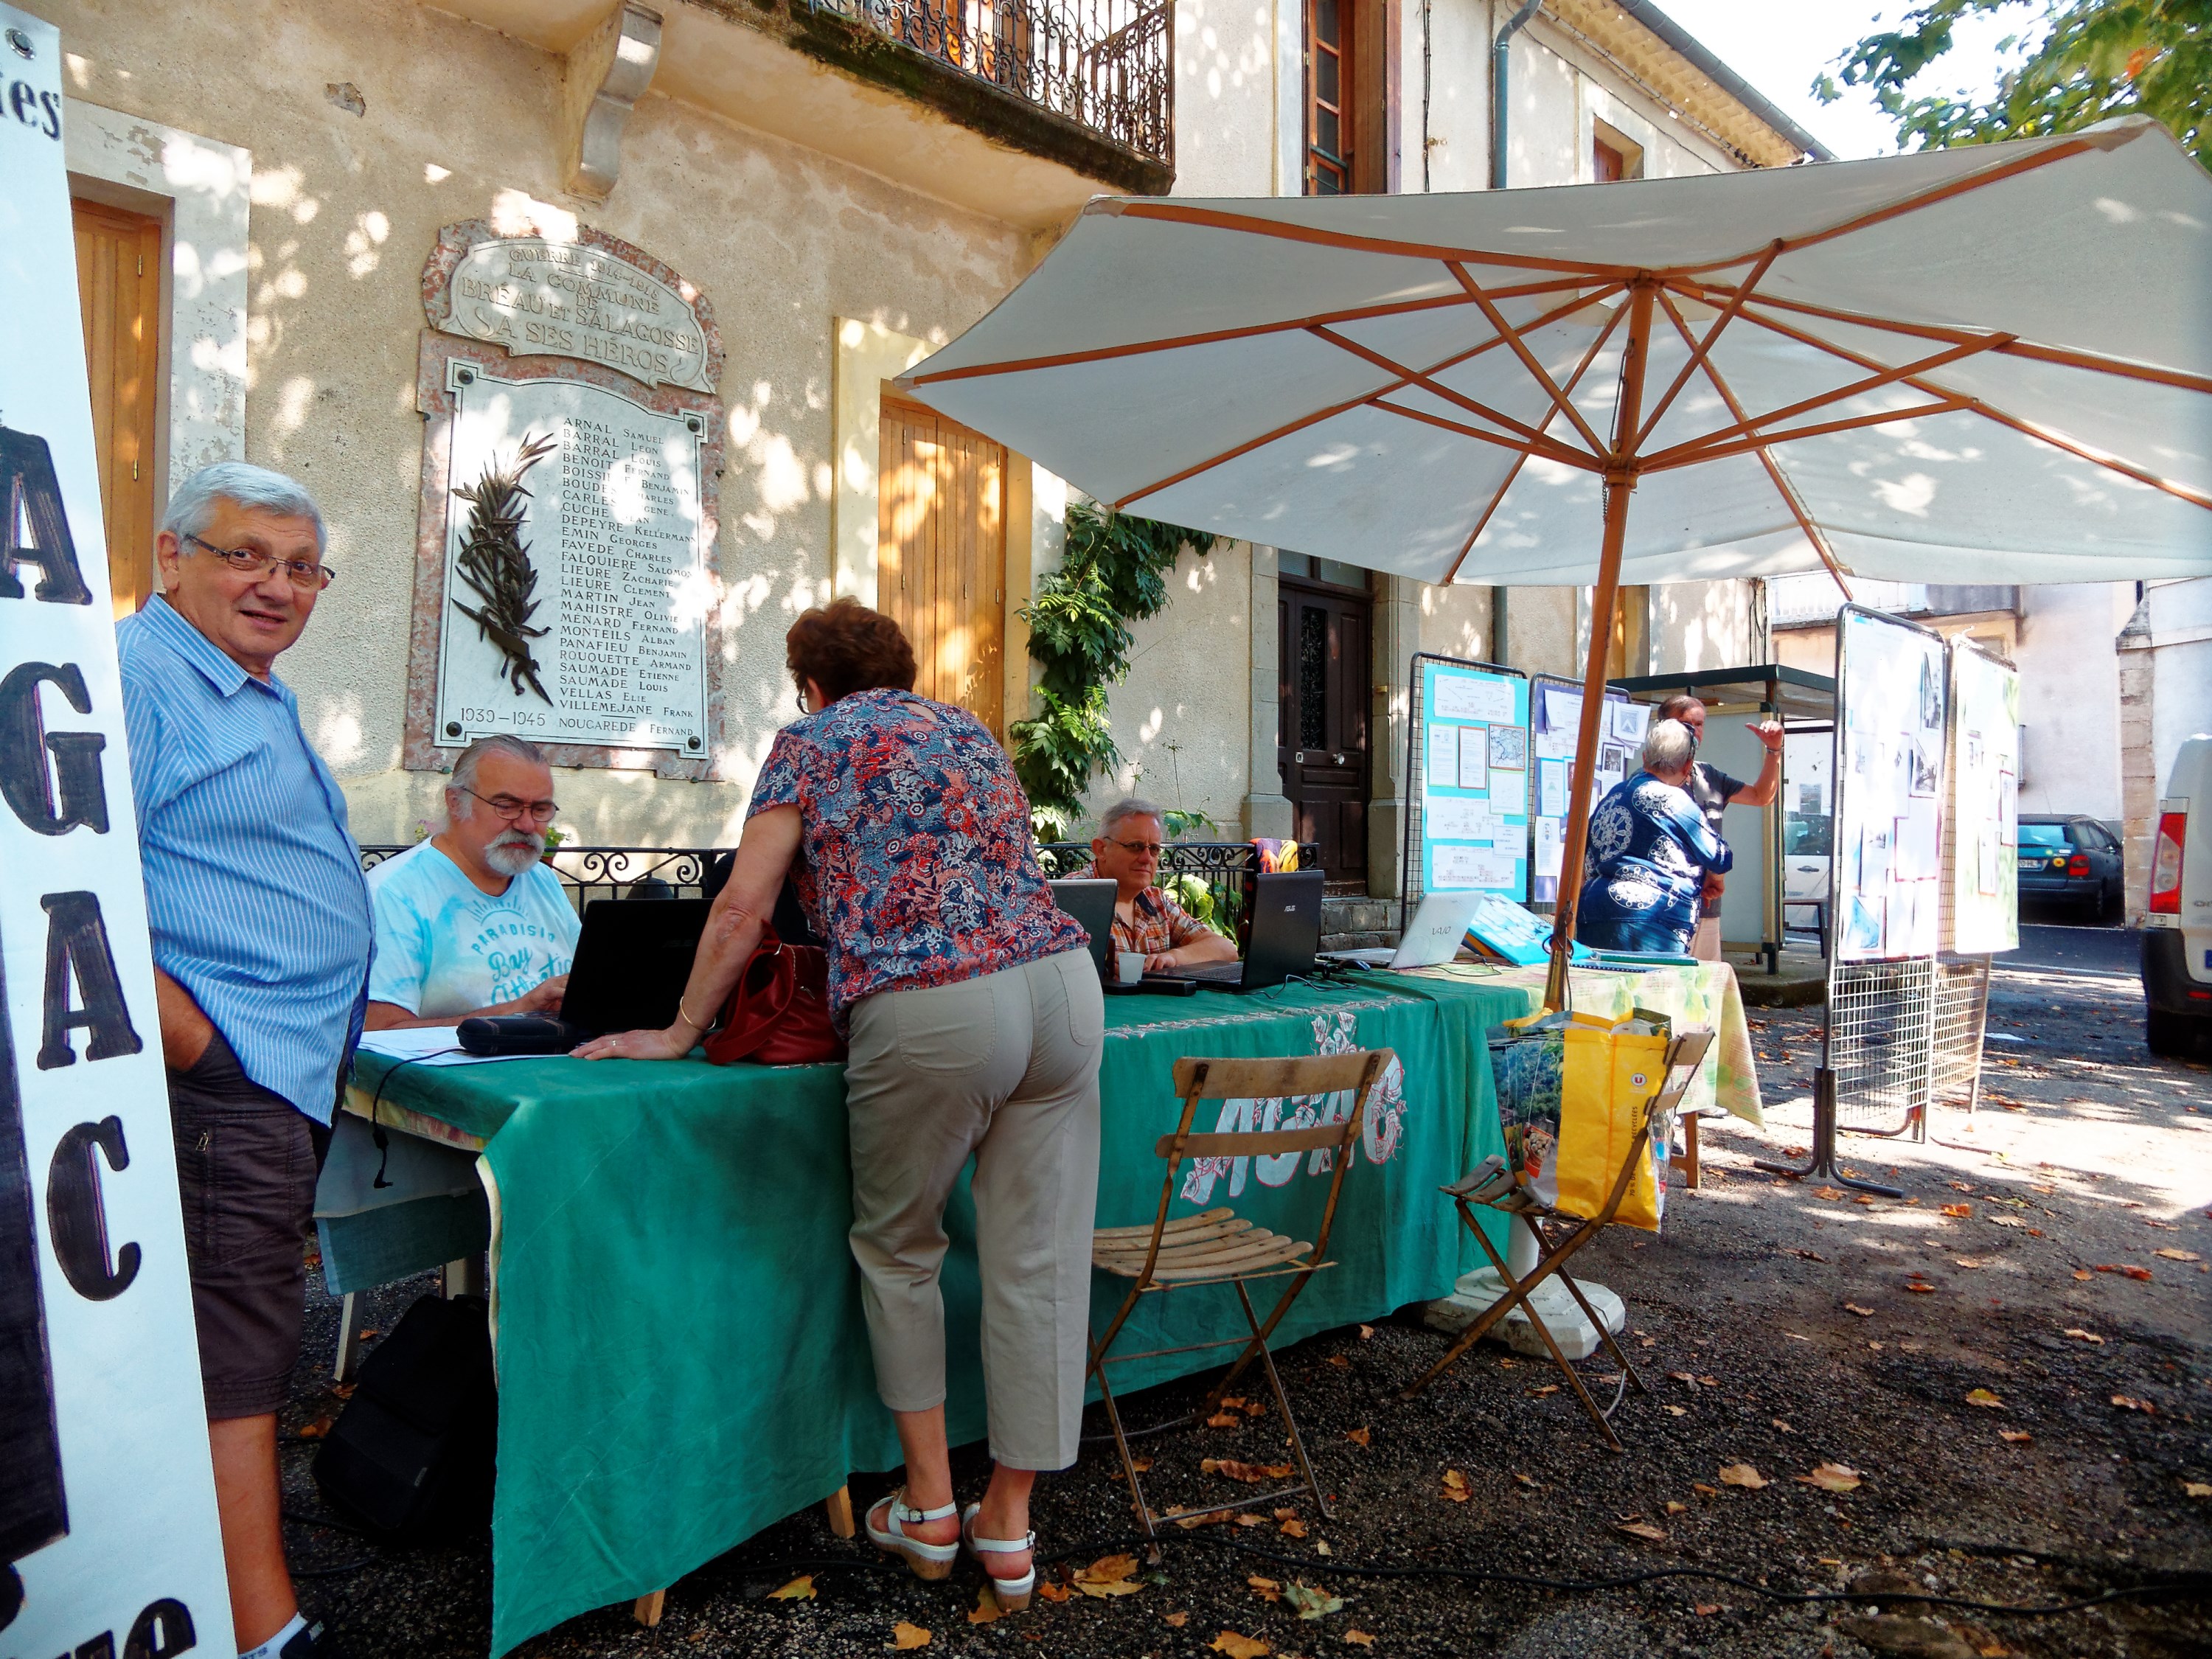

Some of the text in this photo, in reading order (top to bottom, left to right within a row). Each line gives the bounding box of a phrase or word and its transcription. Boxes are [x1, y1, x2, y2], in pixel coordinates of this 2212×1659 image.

[509, 248, 582, 267] GUERRE
[509, 262, 660, 315] LA COMMUNE
[576, 293, 598, 310] DE
[462, 276, 699, 355] BRÉAU ET SALAGOSSE
[526, 321, 575, 351] SES
[583, 335, 669, 373] HÉROS
[563, 417, 664, 444] ARNAL SAMUEL
[563, 428, 658, 455] BARRAL LEON
[563, 441, 661, 467] BARRAL LOUIS
[563, 453, 669, 480] BENOIT FERNAND
[641, 479, 689, 495] BENJAMIN
[638, 493, 674, 505] ARLES
[562, 502, 610, 518] CUCHE
[641, 505, 669, 516] GENE
[562, 515, 625, 532] DEPEYRE
[562, 526, 658, 549] EMIN GEORGES
[562, 539, 672, 563] FAVEDE CHARLES
[562, 551, 637, 571] FALQUIERE
[561, 564, 674, 587] LIEURE ZACHARIE
[561, 576, 671, 598] LIEURE CLEMENT
[560, 588, 655, 608] MARTIN JEAN
[560, 601, 681, 623] MAHISTRE OLIVIE
[560, 625, 675, 645] MONTEILS ALBAN
[632, 621, 678, 634] FERNAND
[560, 638, 686, 658] PANAFIEU BENJAMIN
[560, 650, 692, 671] ROUQUETTE ARMAND
[560, 662, 679, 681] SAUMADE ETIENNE
[560, 675, 668, 692] SAUMADE LOUIS
[560, 687, 647, 702] VELLAS ELIE
[560, 700, 693, 717] VILLEMEJANE FRANK
[650, 724, 693, 736] FERNAND
[471, 923, 556, 956] PARADISIO
[1432, 925, 1452, 936] VAIO
[488, 947, 533, 983] Bay
